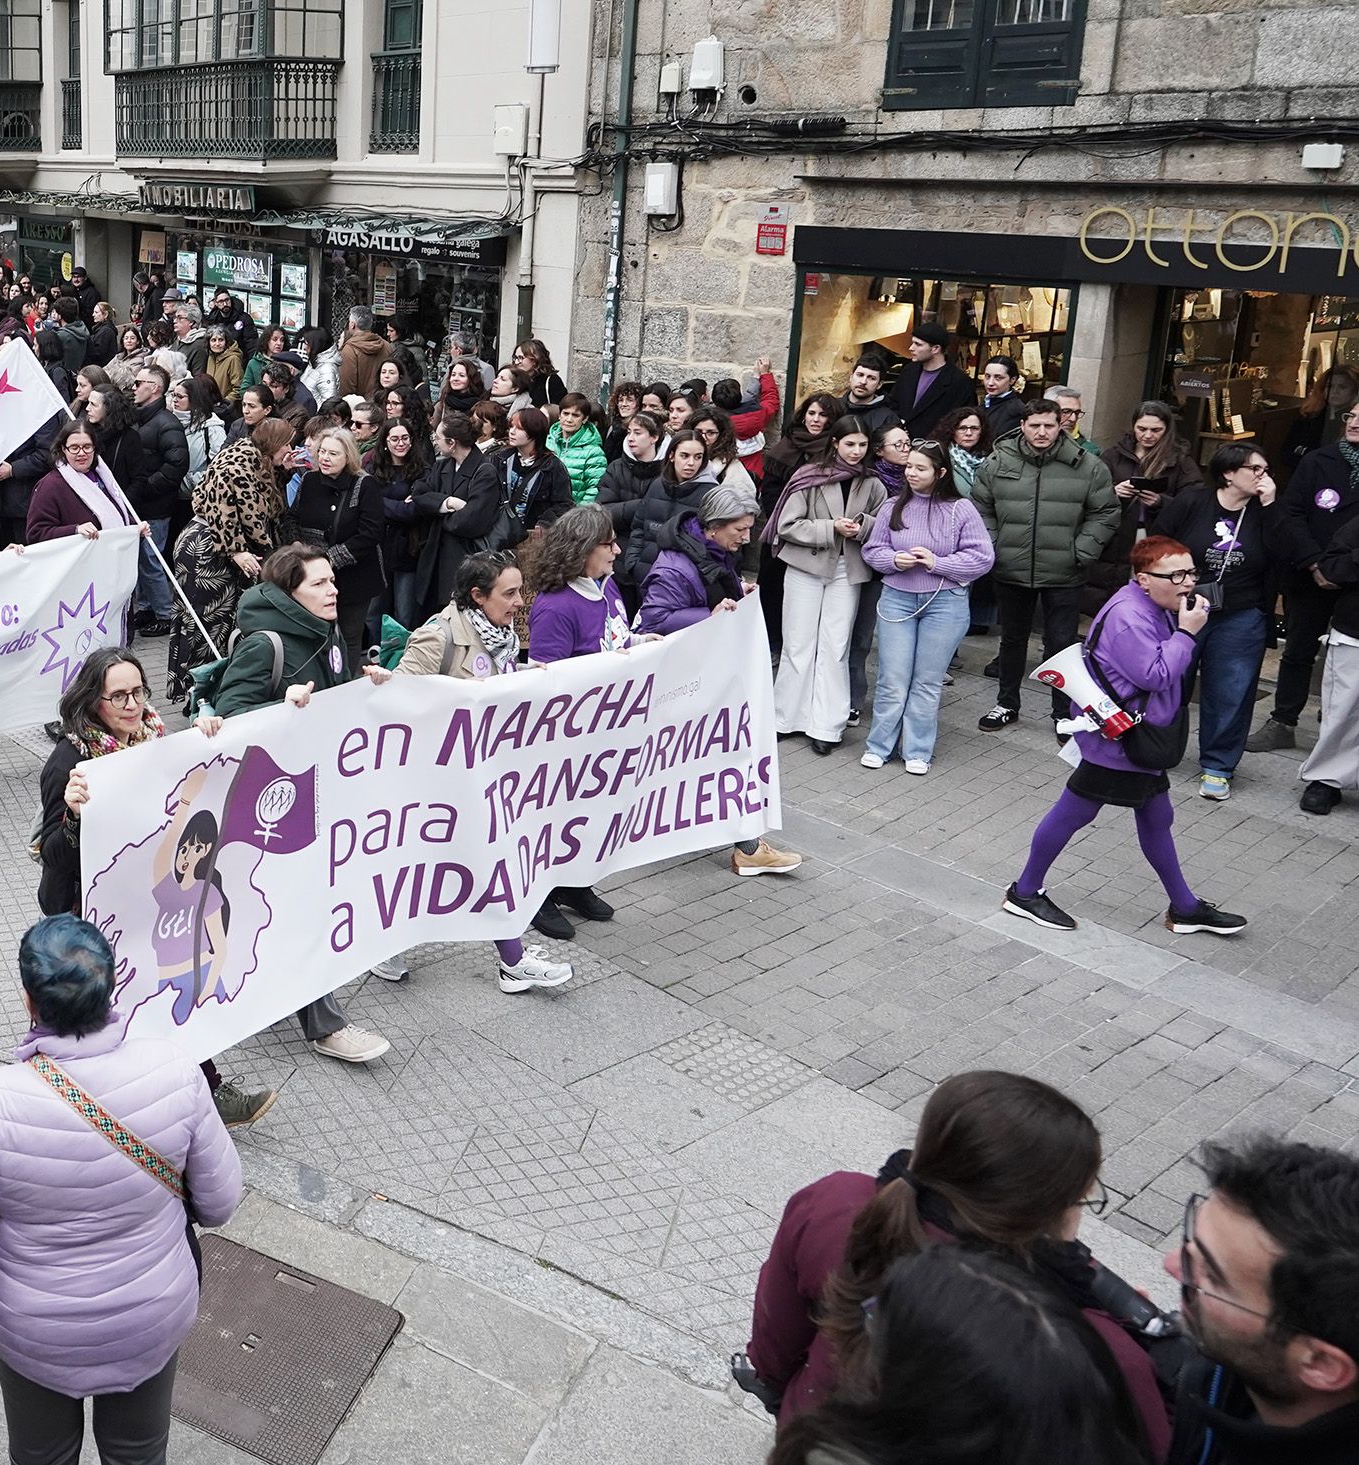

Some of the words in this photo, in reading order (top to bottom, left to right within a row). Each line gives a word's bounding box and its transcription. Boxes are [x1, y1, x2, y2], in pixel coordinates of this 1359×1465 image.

[326, 230, 414, 253] AGASALLO
[421, 247, 441, 256] regalo
[449, 250, 481, 259] souvenirs
[760, 225, 785, 234] Alarma
[1080, 206, 1359, 277] otton
[216, 254, 266, 275] PEDROSA
[337, 723, 413, 778] en
[434, 672, 655, 770] MARCHA
[329, 802, 458, 888] para
[484, 700, 752, 845] TRANSFORMAR
[331, 902, 354, 953] a
[372, 858, 516, 931] VIDA
[517, 816, 590, 899] DAS
[594, 755, 772, 864] MULLERES
